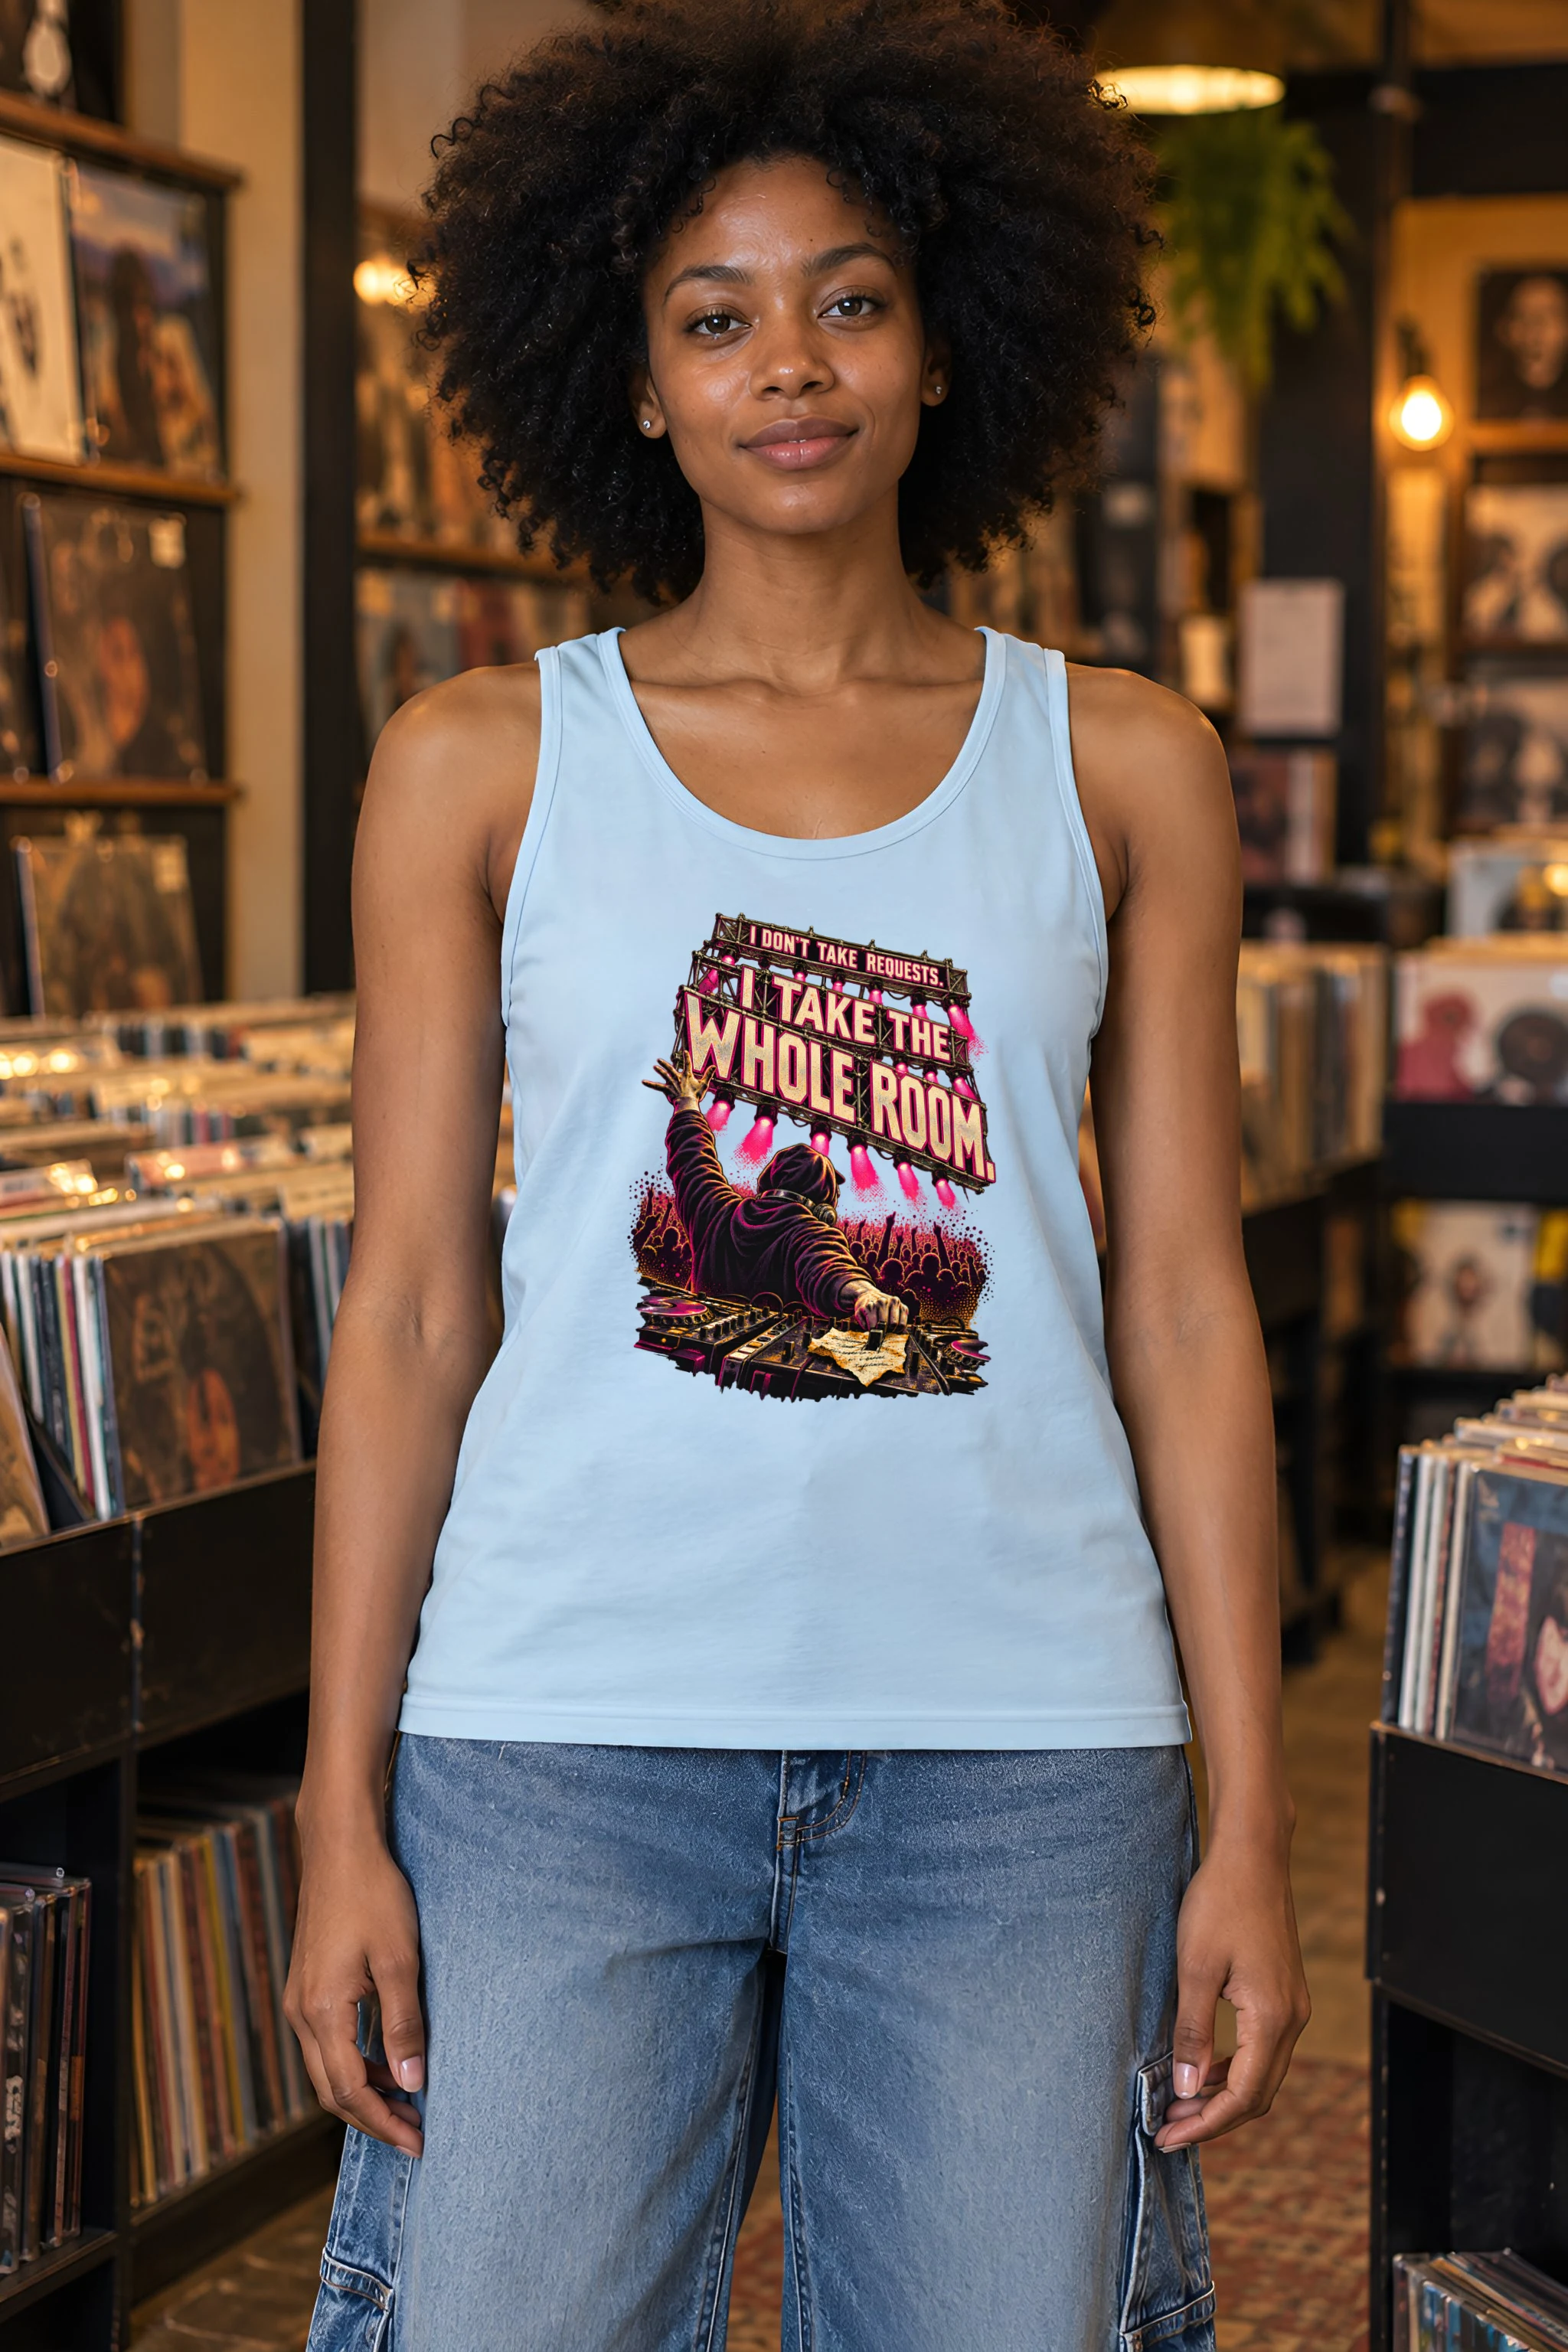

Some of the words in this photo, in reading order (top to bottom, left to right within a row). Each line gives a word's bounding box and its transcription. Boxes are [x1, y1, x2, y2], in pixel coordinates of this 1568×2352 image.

[750, 925, 757, 945] I
[761, 928, 810, 958] DON'T
[816, 941, 858, 969] TAKE
[866, 952, 944, 988] REQUESTS.
[740, 965, 755, 1011] I
[772, 974, 876, 1046] TAKE
[887, 1009, 951, 1063] THE
[684, 991, 856, 1124] WHOLE
[870, 1059, 996, 1183] ROOM.
